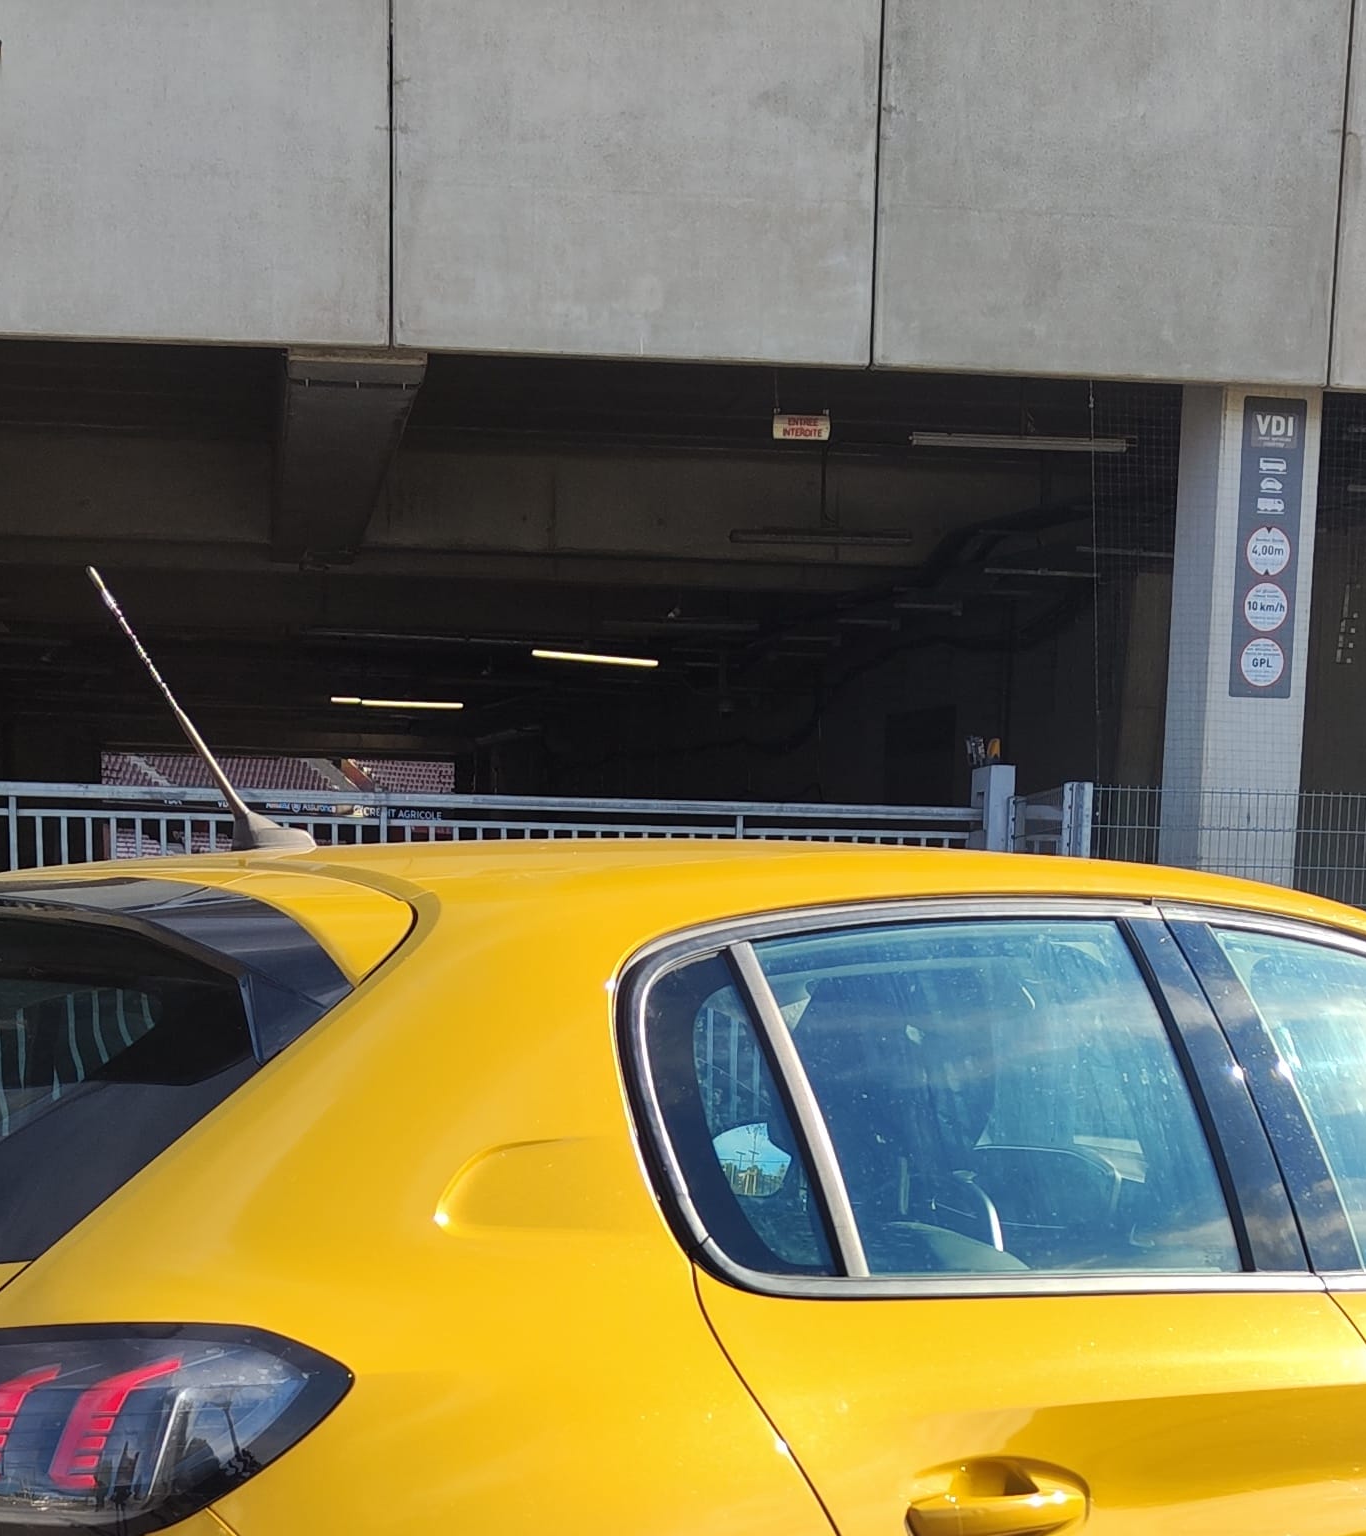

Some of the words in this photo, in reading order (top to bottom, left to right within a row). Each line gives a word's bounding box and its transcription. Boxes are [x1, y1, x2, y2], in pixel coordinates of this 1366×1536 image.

[1256, 413, 1295, 437] VDI
[782, 427, 823, 438] INTERDITE
[1247, 600, 1258, 612] 10
[1259, 601, 1286, 613] km/h
[1251, 656, 1273, 669] GPL
[397, 808, 443, 821] AGRICOLE
